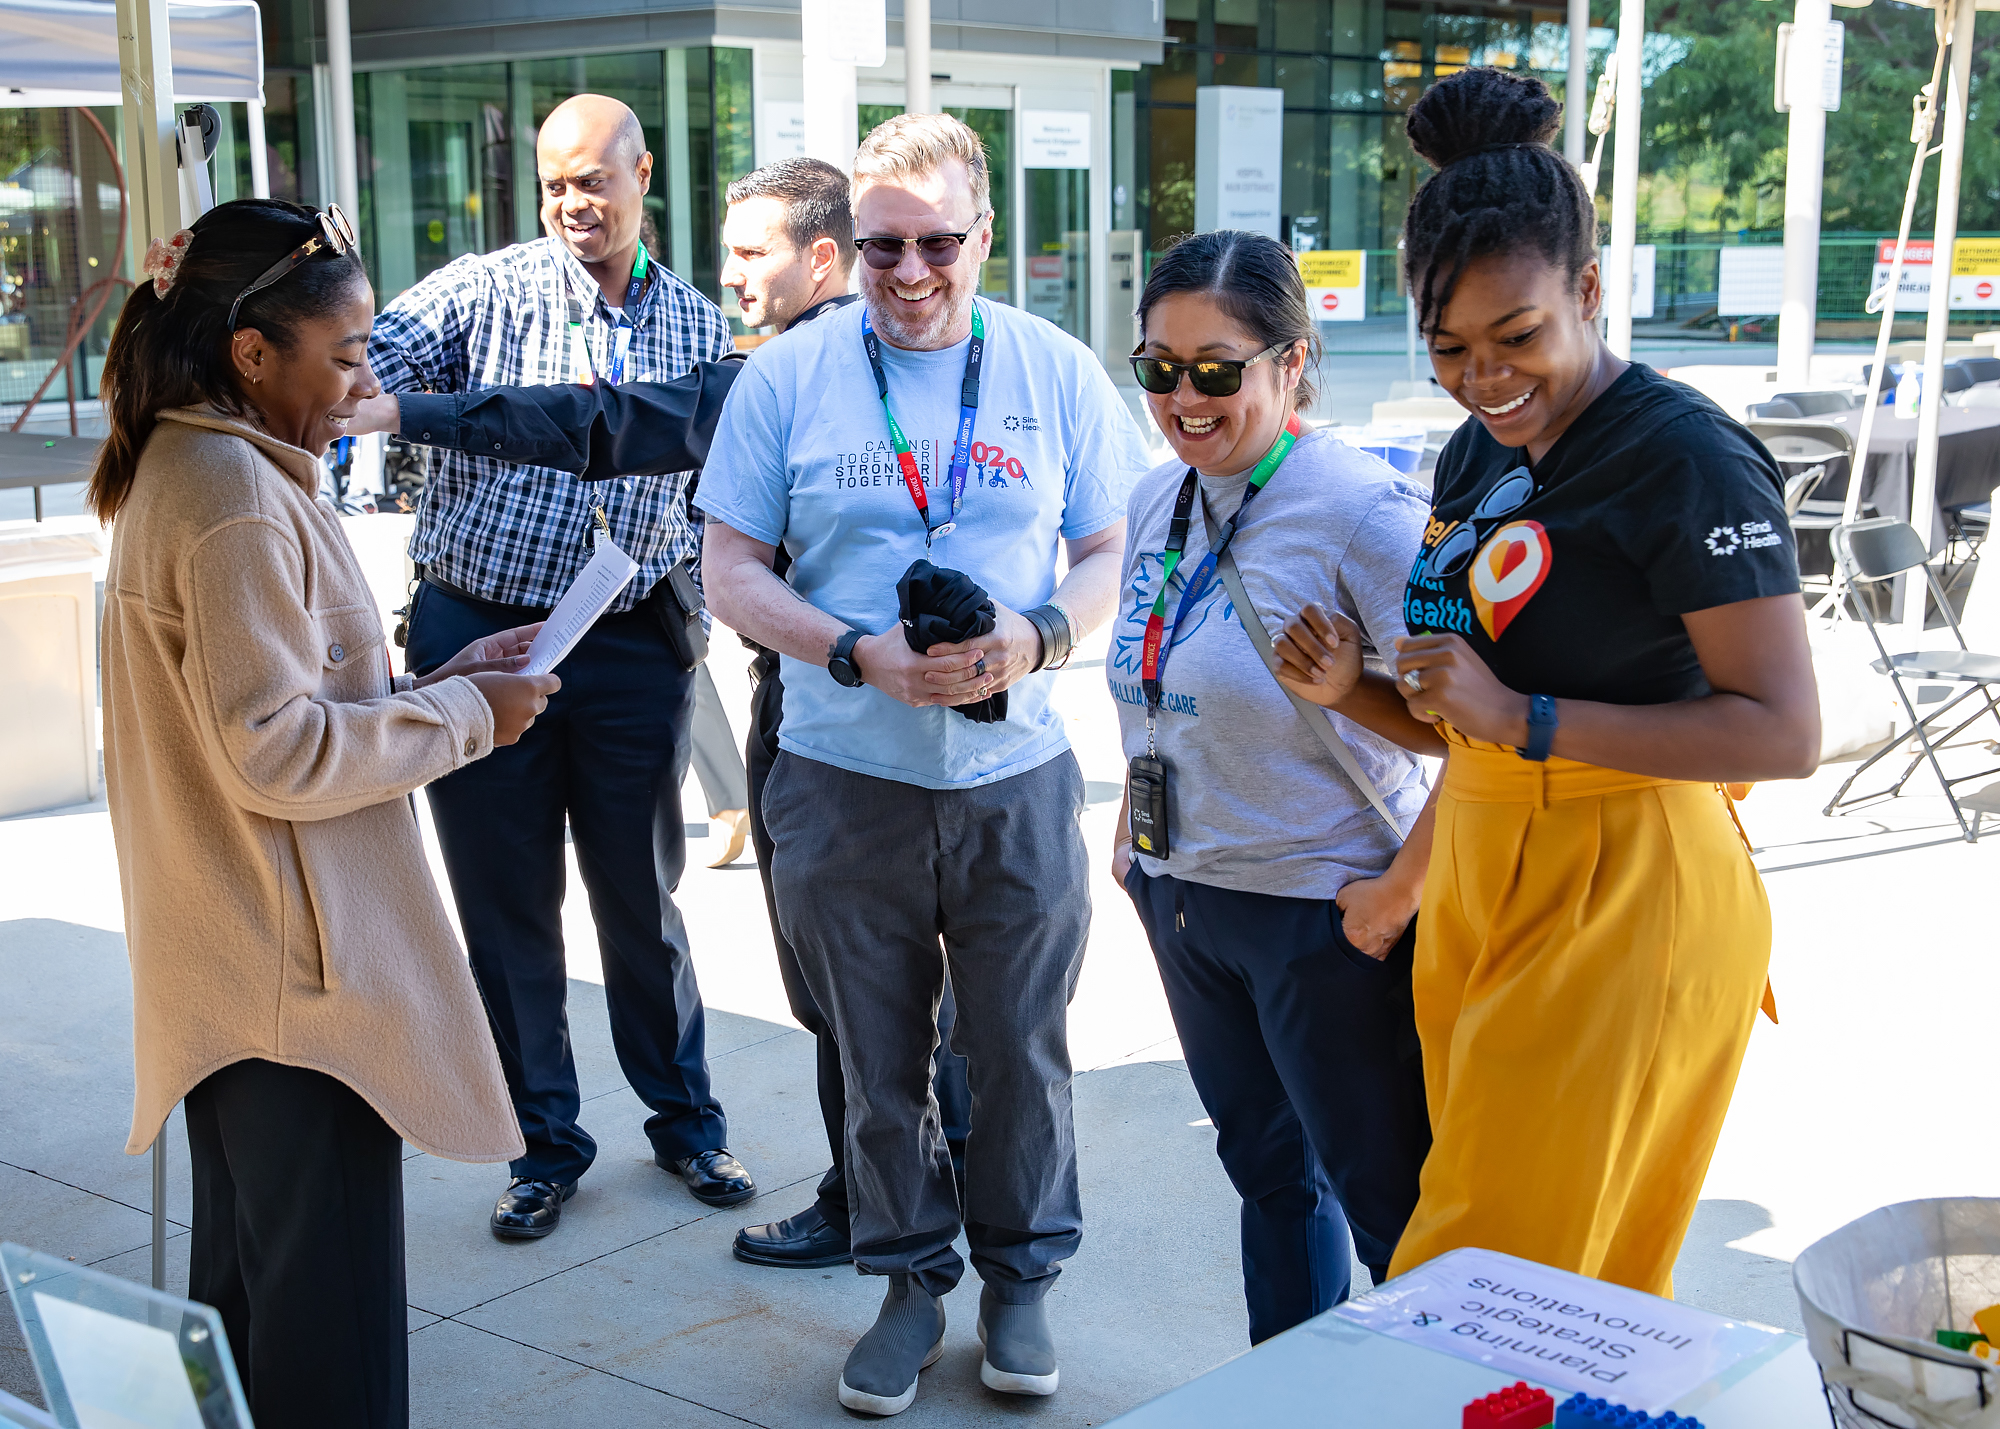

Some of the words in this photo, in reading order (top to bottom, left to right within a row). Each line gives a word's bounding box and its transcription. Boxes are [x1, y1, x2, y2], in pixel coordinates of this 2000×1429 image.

[866, 440, 930, 452] CARNG
[1269, 439, 1287, 465] HUMANITY
[838, 451, 930, 466] TOGETER
[836, 475, 930, 490] TOGETHR
[1740, 520, 1772, 536] Sinai
[1742, 532, 1782, 550] Health
[1146, 642, 1156, 667] SERVICE
[1168, 692, 1200, 716] CARE
[1412, 1310, 1442, 1328] &
[1467, 1276, 1693, 1350] Innovations
[1460, 1300, 1636, 1361] Strategic
[1450, 1320, 1628, 1384] Planning
